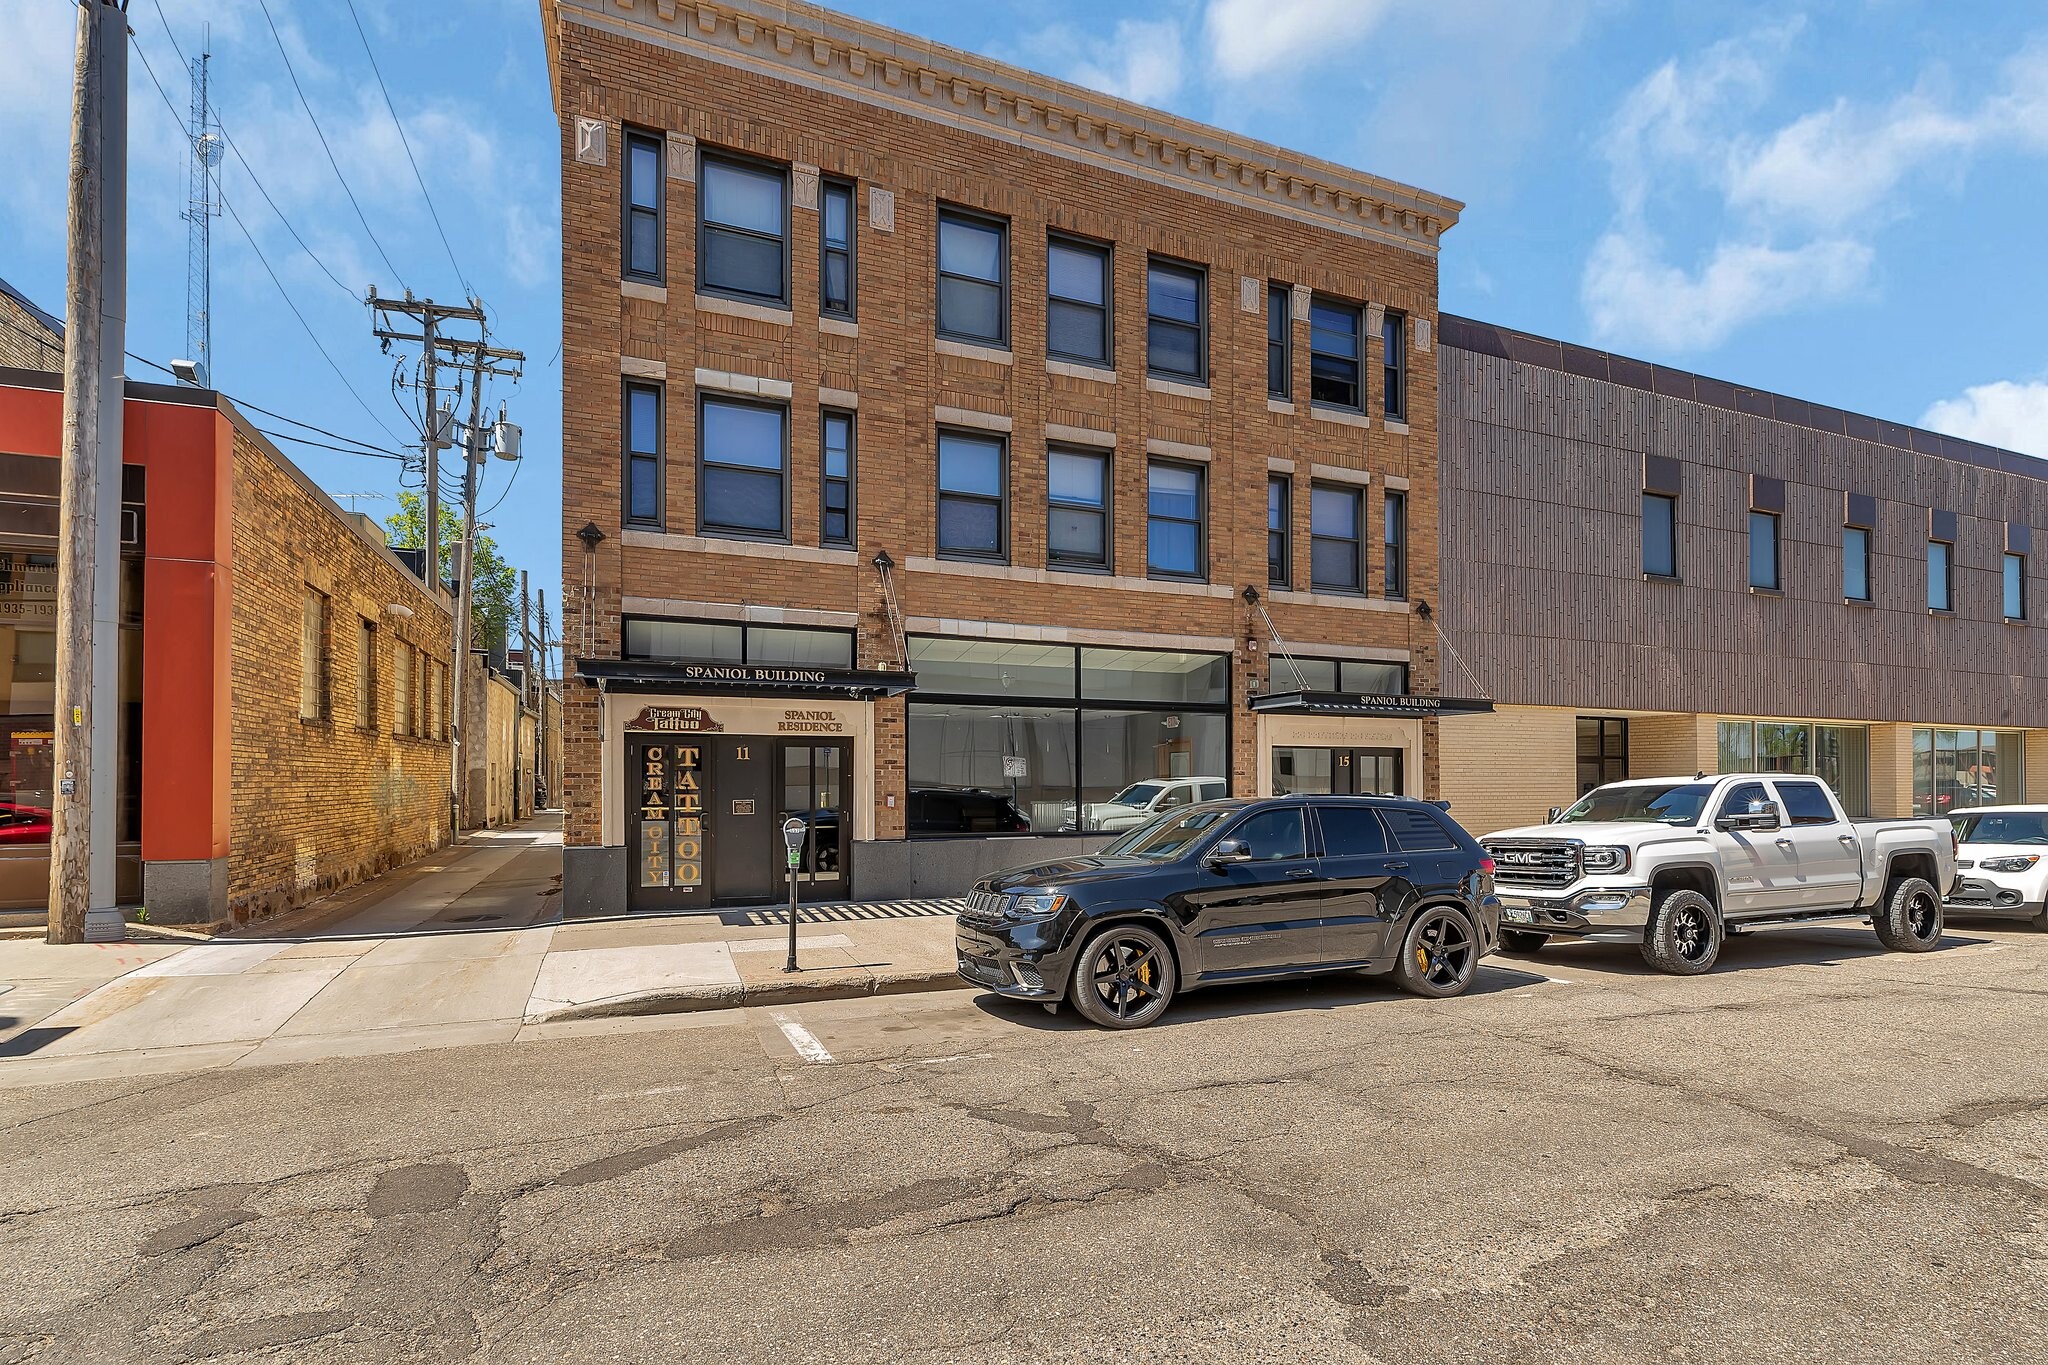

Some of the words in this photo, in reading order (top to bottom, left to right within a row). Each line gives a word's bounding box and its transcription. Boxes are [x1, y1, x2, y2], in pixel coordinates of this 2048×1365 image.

[686, 666, 750, 680] SPANIOL
[755, 669, 825, 683] BUILDING
[1361, 695, 1398, 706] SPANIOL
[1400, 697, 1440, 708] BUILDING
[649, 708, 680, 719] Cream
[681, 708, 702, 720] City
[784, 710, 836, 720] SPANIOL
[645, 717, 700, 731] Tattoo
[778, 721, 843, 732] RESIDENCE
[736, 746, 751, 760] 11
[1338, 756, 1350, 767] 15
[646, 747, 665, 820] CREAM
[676, 747, 699, 882] TATTOO
[1504, 852, 1543, 864] GMC
